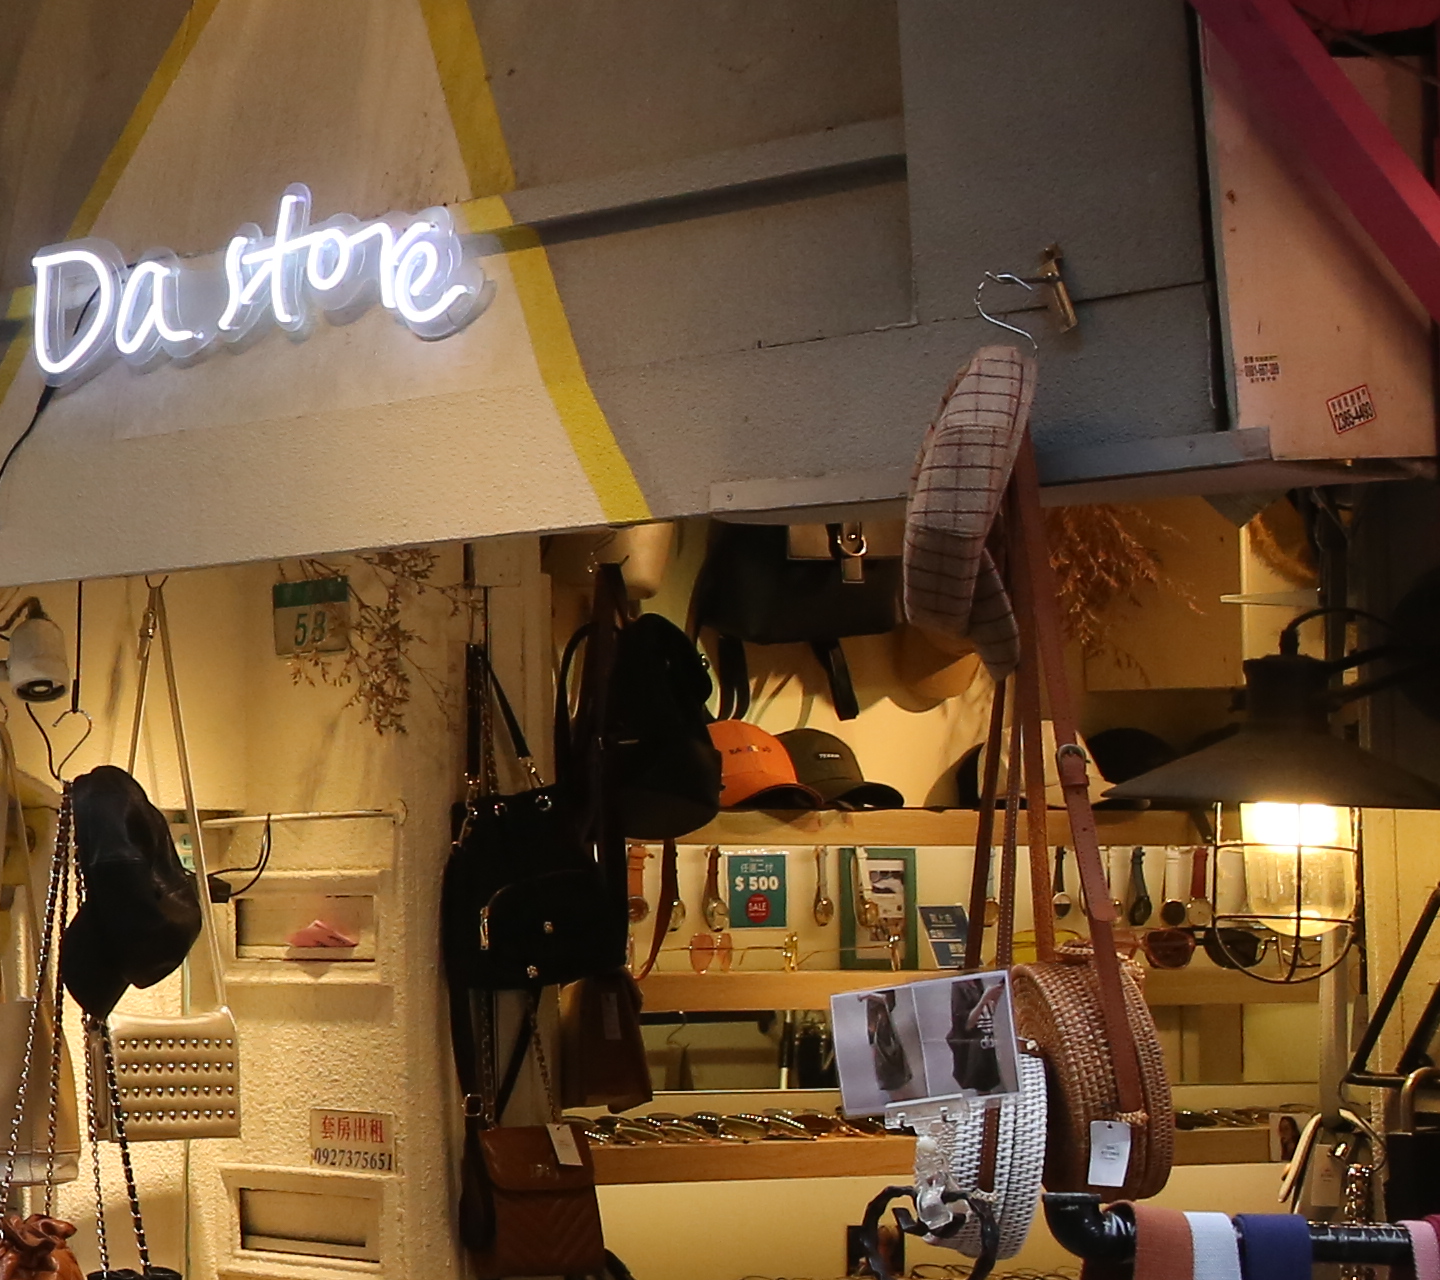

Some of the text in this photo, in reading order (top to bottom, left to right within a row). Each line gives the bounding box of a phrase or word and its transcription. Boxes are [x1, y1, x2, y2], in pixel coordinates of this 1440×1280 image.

[31, 192, 472, 376] Da store
[295, 611, 326, 647] 58
[749, 876, 779, 891] 500
[321, 1115, 384, 1143] 套房出租
[314, 1147, 393, 1171] 0927375651
